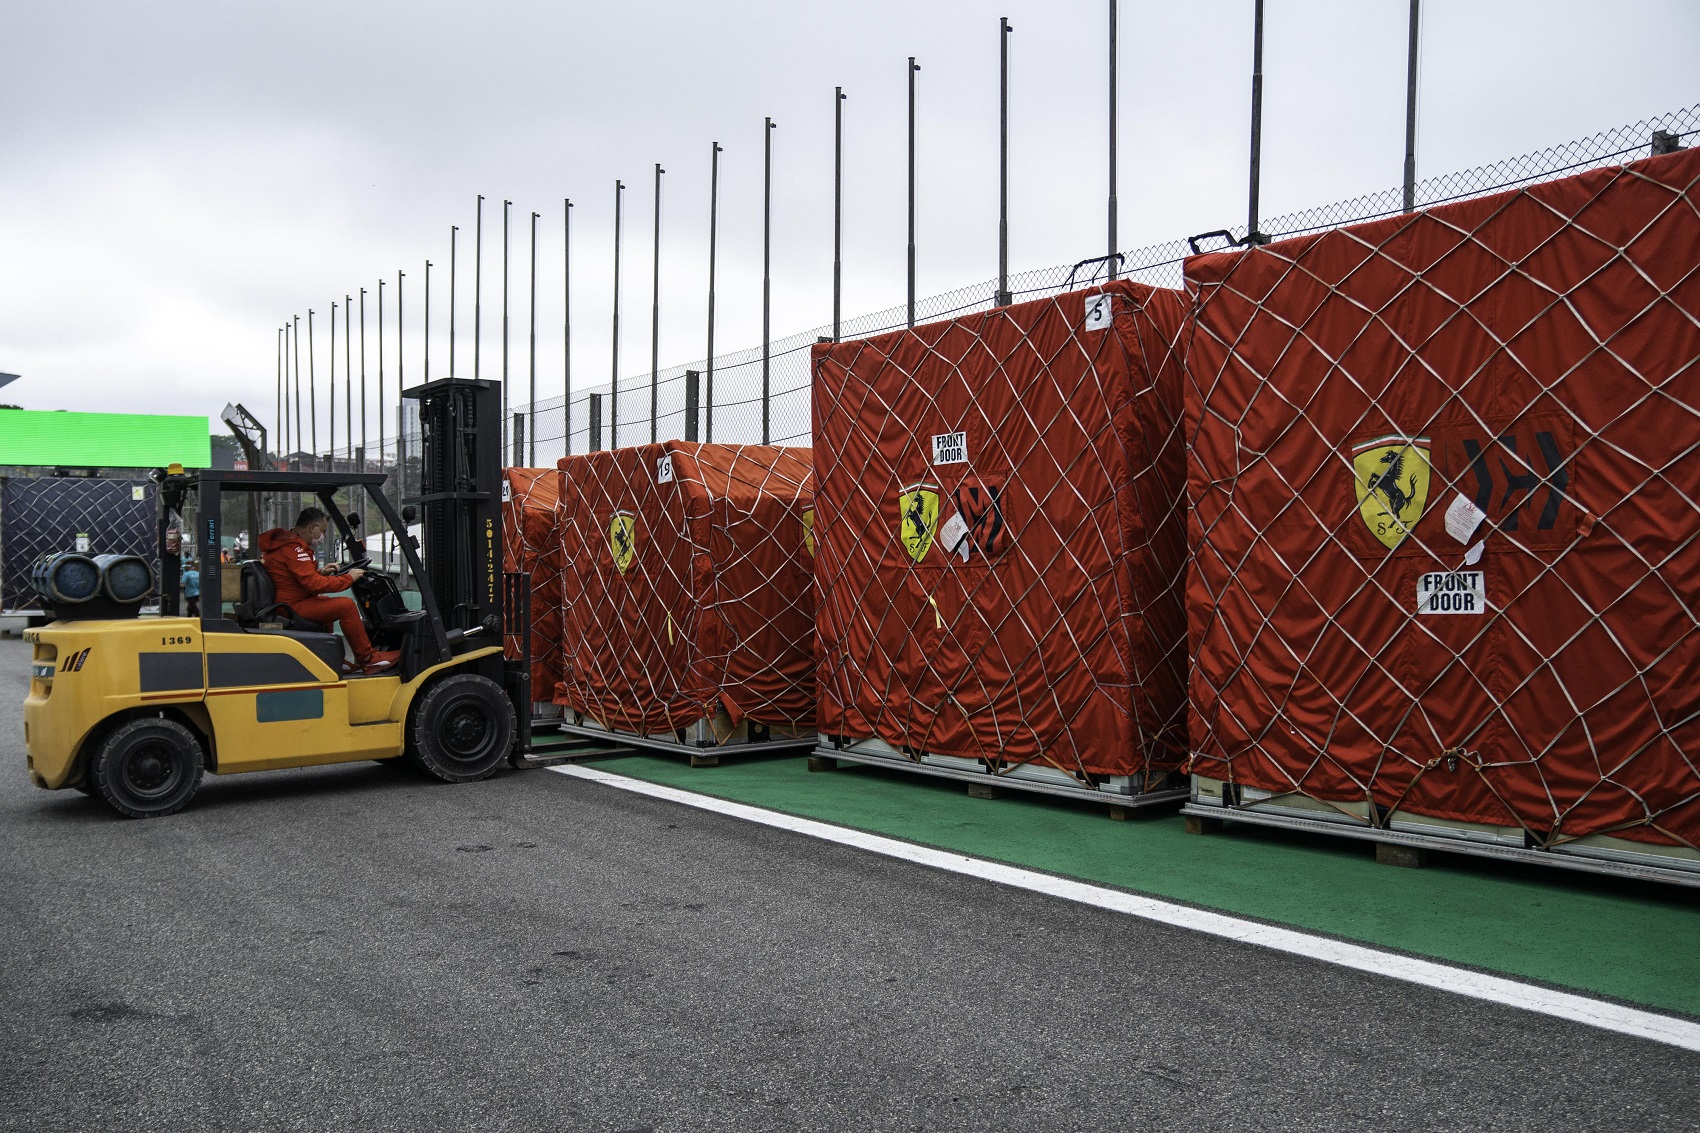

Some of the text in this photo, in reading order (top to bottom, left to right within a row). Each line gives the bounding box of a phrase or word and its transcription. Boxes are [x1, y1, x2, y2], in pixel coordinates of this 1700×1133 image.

[1094, 302, 1103, 322] 5
[936, 433, 964, 449] FRONT
[940, 447, 962, 463] DOOR
[660, 462, 670, 478] 19
[207, 519, 215, 545] Ferrari
[1423, 572, 1479, 592] FRONT
[1429, 592, 1475, 612] DOOR
[161, 635, 192, 646] 1369
